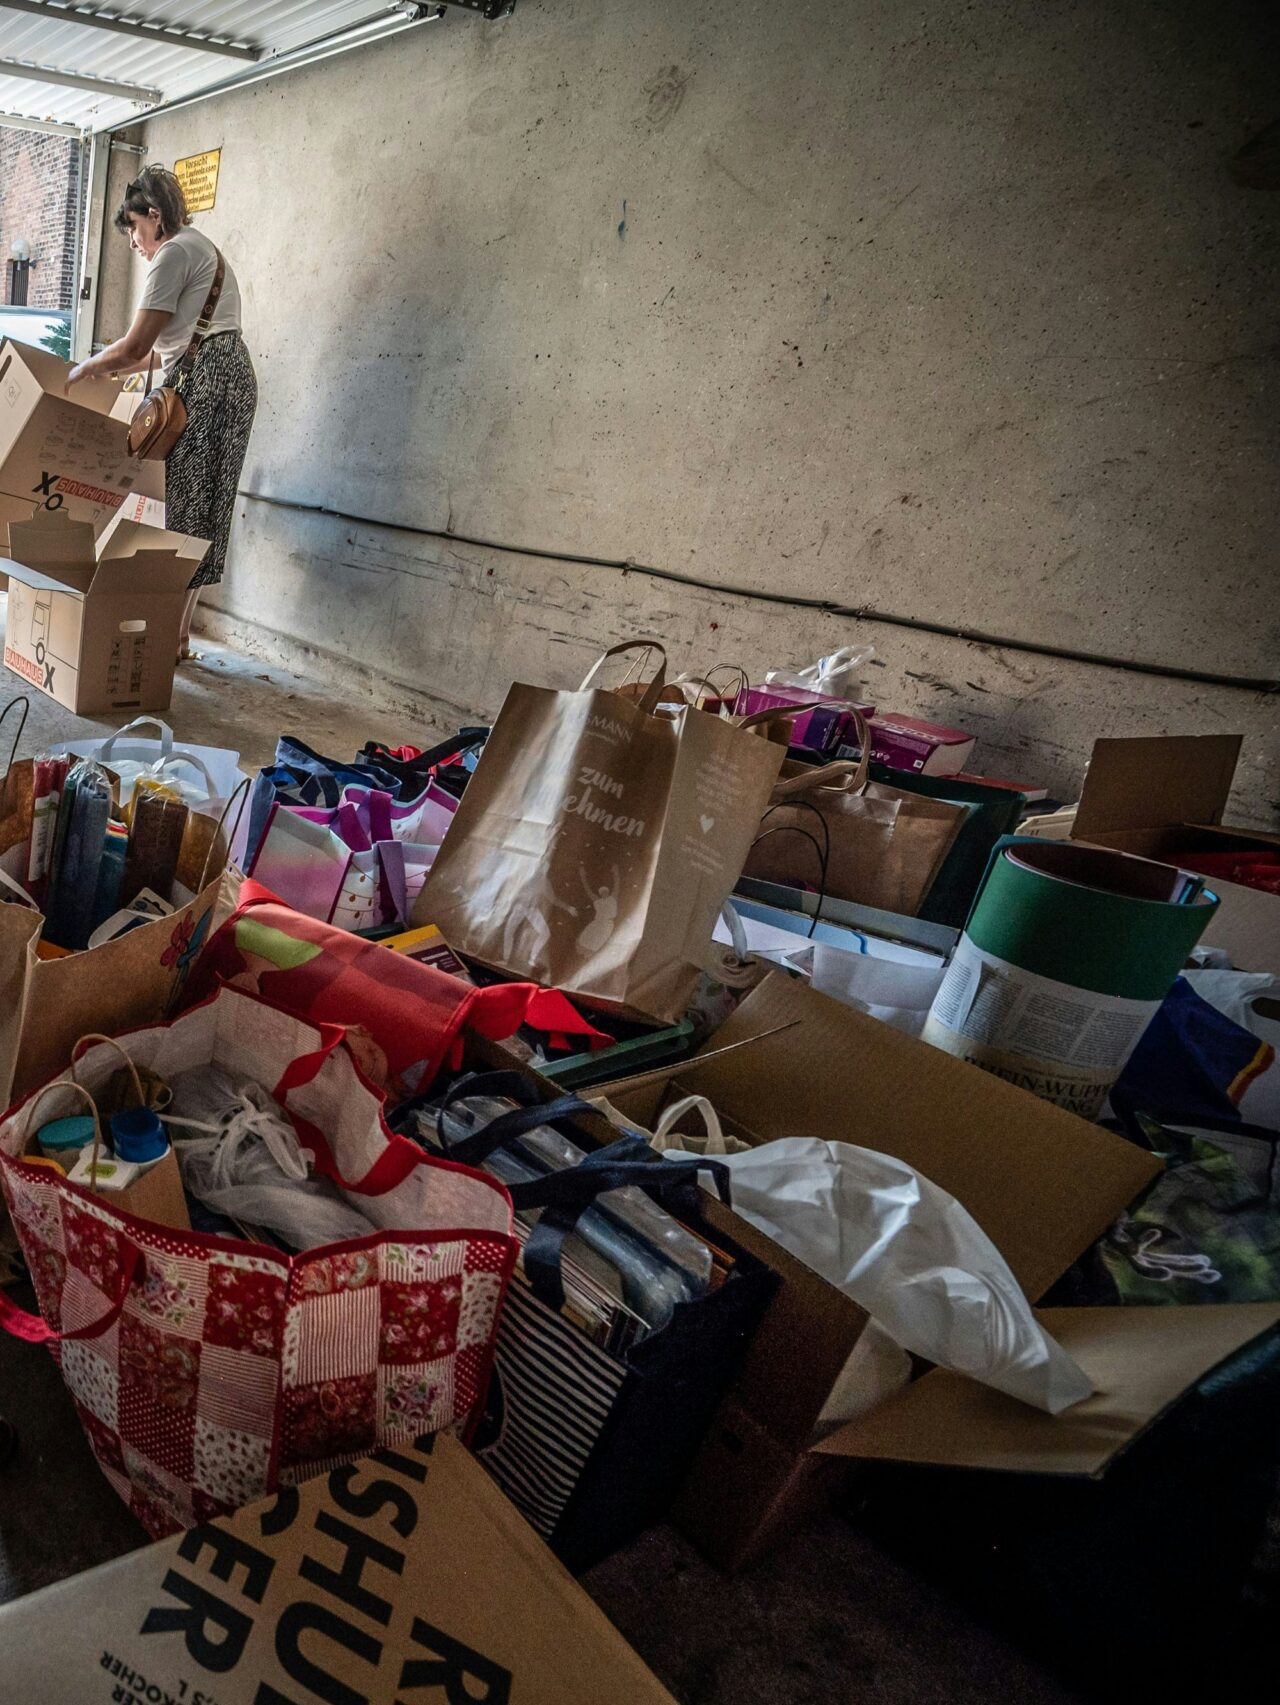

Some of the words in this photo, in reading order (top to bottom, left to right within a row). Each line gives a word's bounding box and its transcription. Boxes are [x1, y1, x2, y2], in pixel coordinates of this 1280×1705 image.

[55, 477, 124, 507] BAUHAUS
[5, 647, 44, 687] BAUHAUS
[578, 766, 624, 799] zum
[562, 785, 646, 837] ehmen
